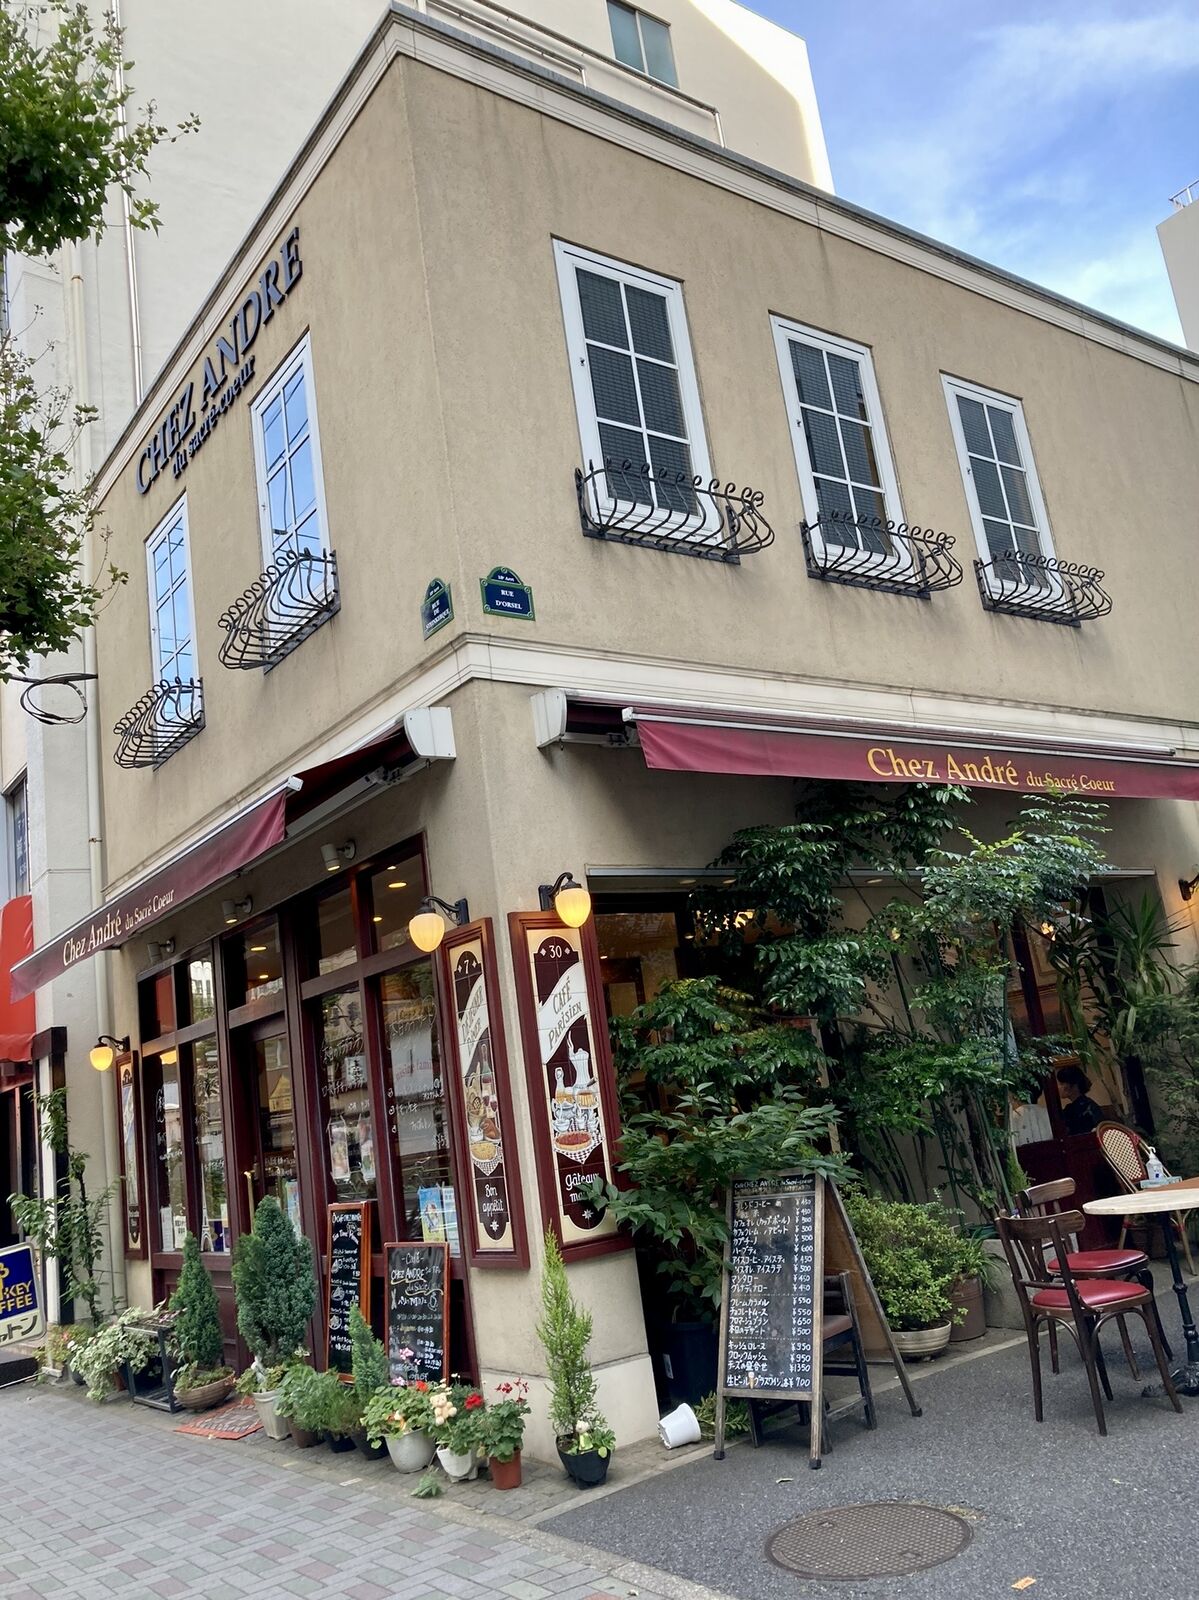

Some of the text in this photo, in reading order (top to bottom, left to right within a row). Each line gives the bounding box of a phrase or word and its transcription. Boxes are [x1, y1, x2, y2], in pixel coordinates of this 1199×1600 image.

[135, 226, 303, 495] CHEZ ANDRE
[173, 450, 188, 480] du
[501, 589, 514, 597] RUE
[495, 600, 523, 610] D'ORSEL
[867, 748, 1115, 792] Chez André du Sacré Coeur
[63, 889, 174, 966] Chez André du Sacré Coeur
[549, 945, 562, 958] 30
[463, 960, 469, 974] 7
[553, 976, 572, 1014] CAFÉ
[484, 1184, 498, 1198] Bon
[795, 1225, 812, 1233] ¥500
[795, 1234, 813, 1243] ¥500
[794, 1244, 813, 1253] ¥600
[794, 1254, 812, 1264] ¥450
[793, 1264, 811, 1272] ¥500
[792, 1307, 812, 1316] ¥550
[792, 1316, 812, 1326] ¥650
[791, 1327, 811, 1336] ¥500
[791, 1342, 811, 1352] ¥950
[790, 1353, 811, 1363] ¥950
[789, 1362, 811, 1373] ¥1350
